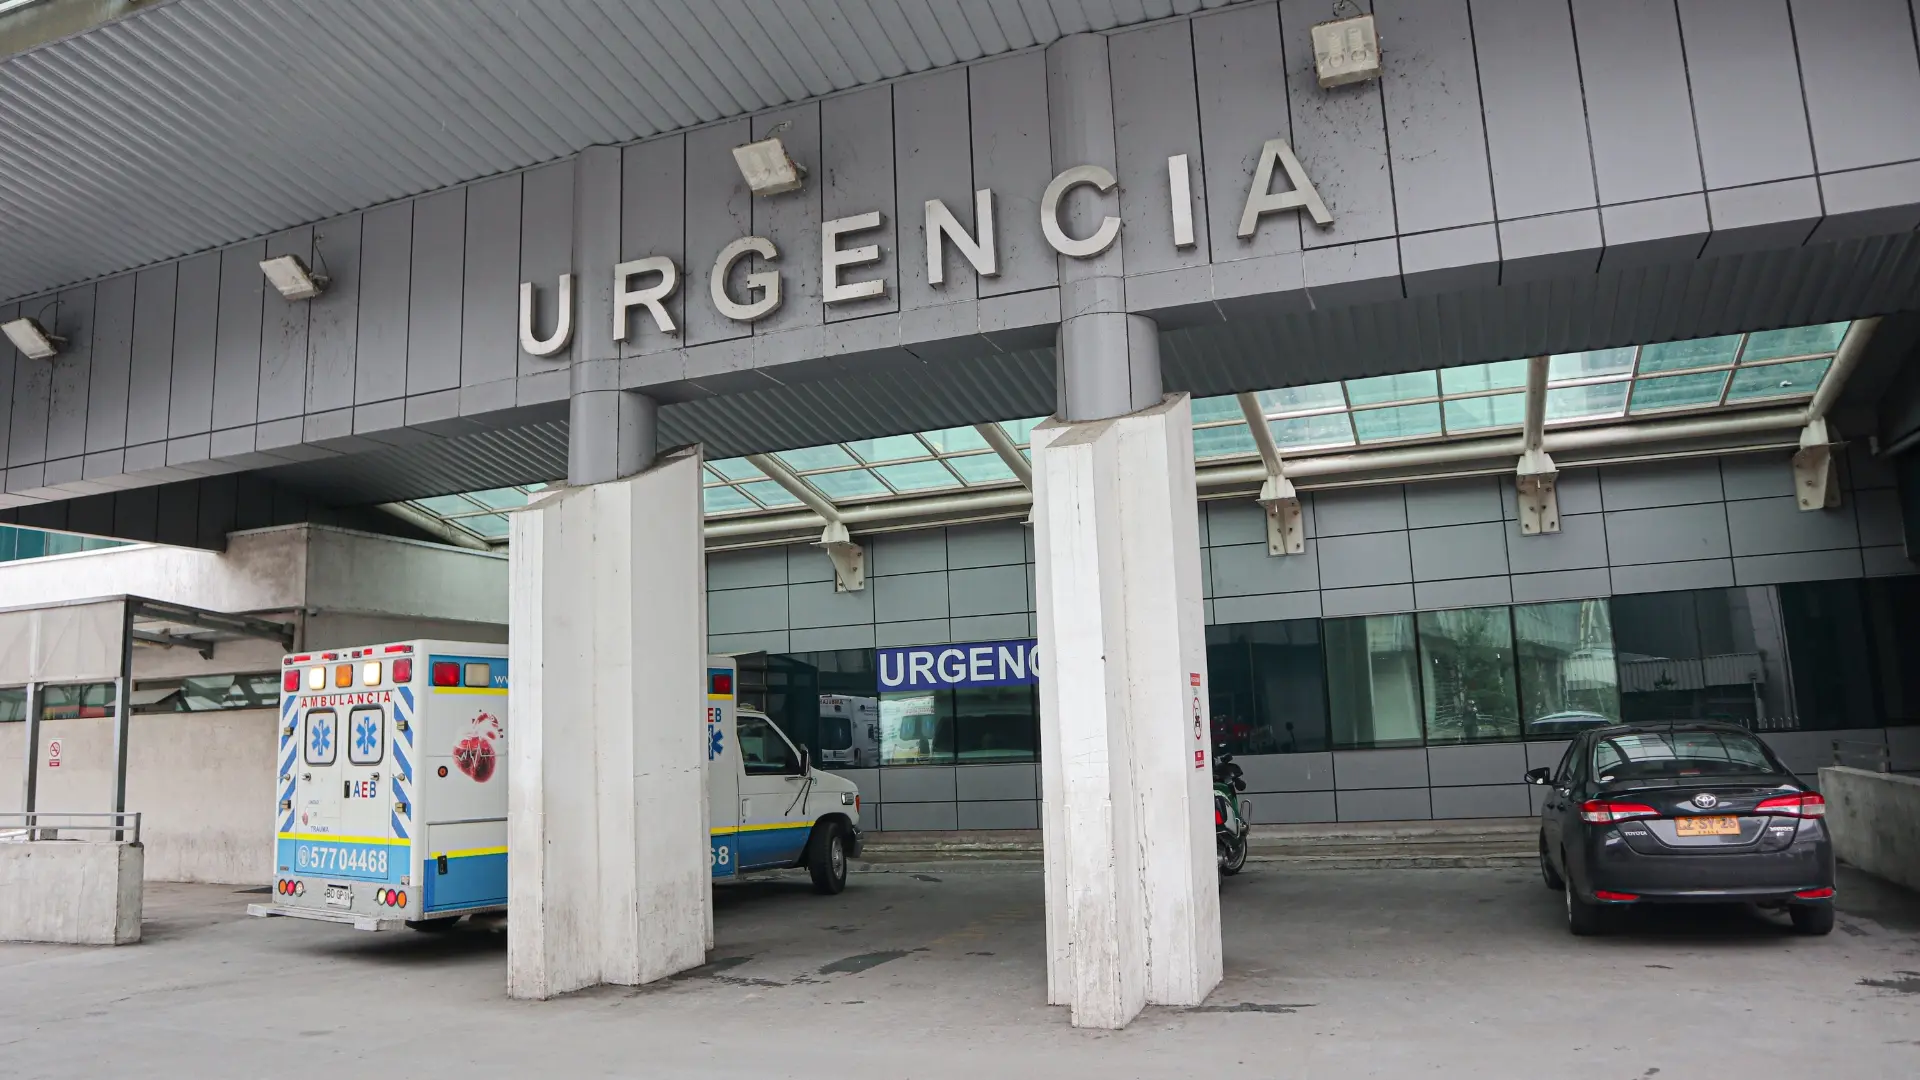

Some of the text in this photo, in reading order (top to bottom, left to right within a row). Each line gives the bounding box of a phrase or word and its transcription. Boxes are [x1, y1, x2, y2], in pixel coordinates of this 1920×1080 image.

[519, 138, 1335, 357] URGENCIA
[301, 691, 391, 708] AMBULANCIA
[353, 780, 377, 798] AEB
[310, 825, 330, 833] TRAUMA
[310, 846, 388, 873] 57704468
